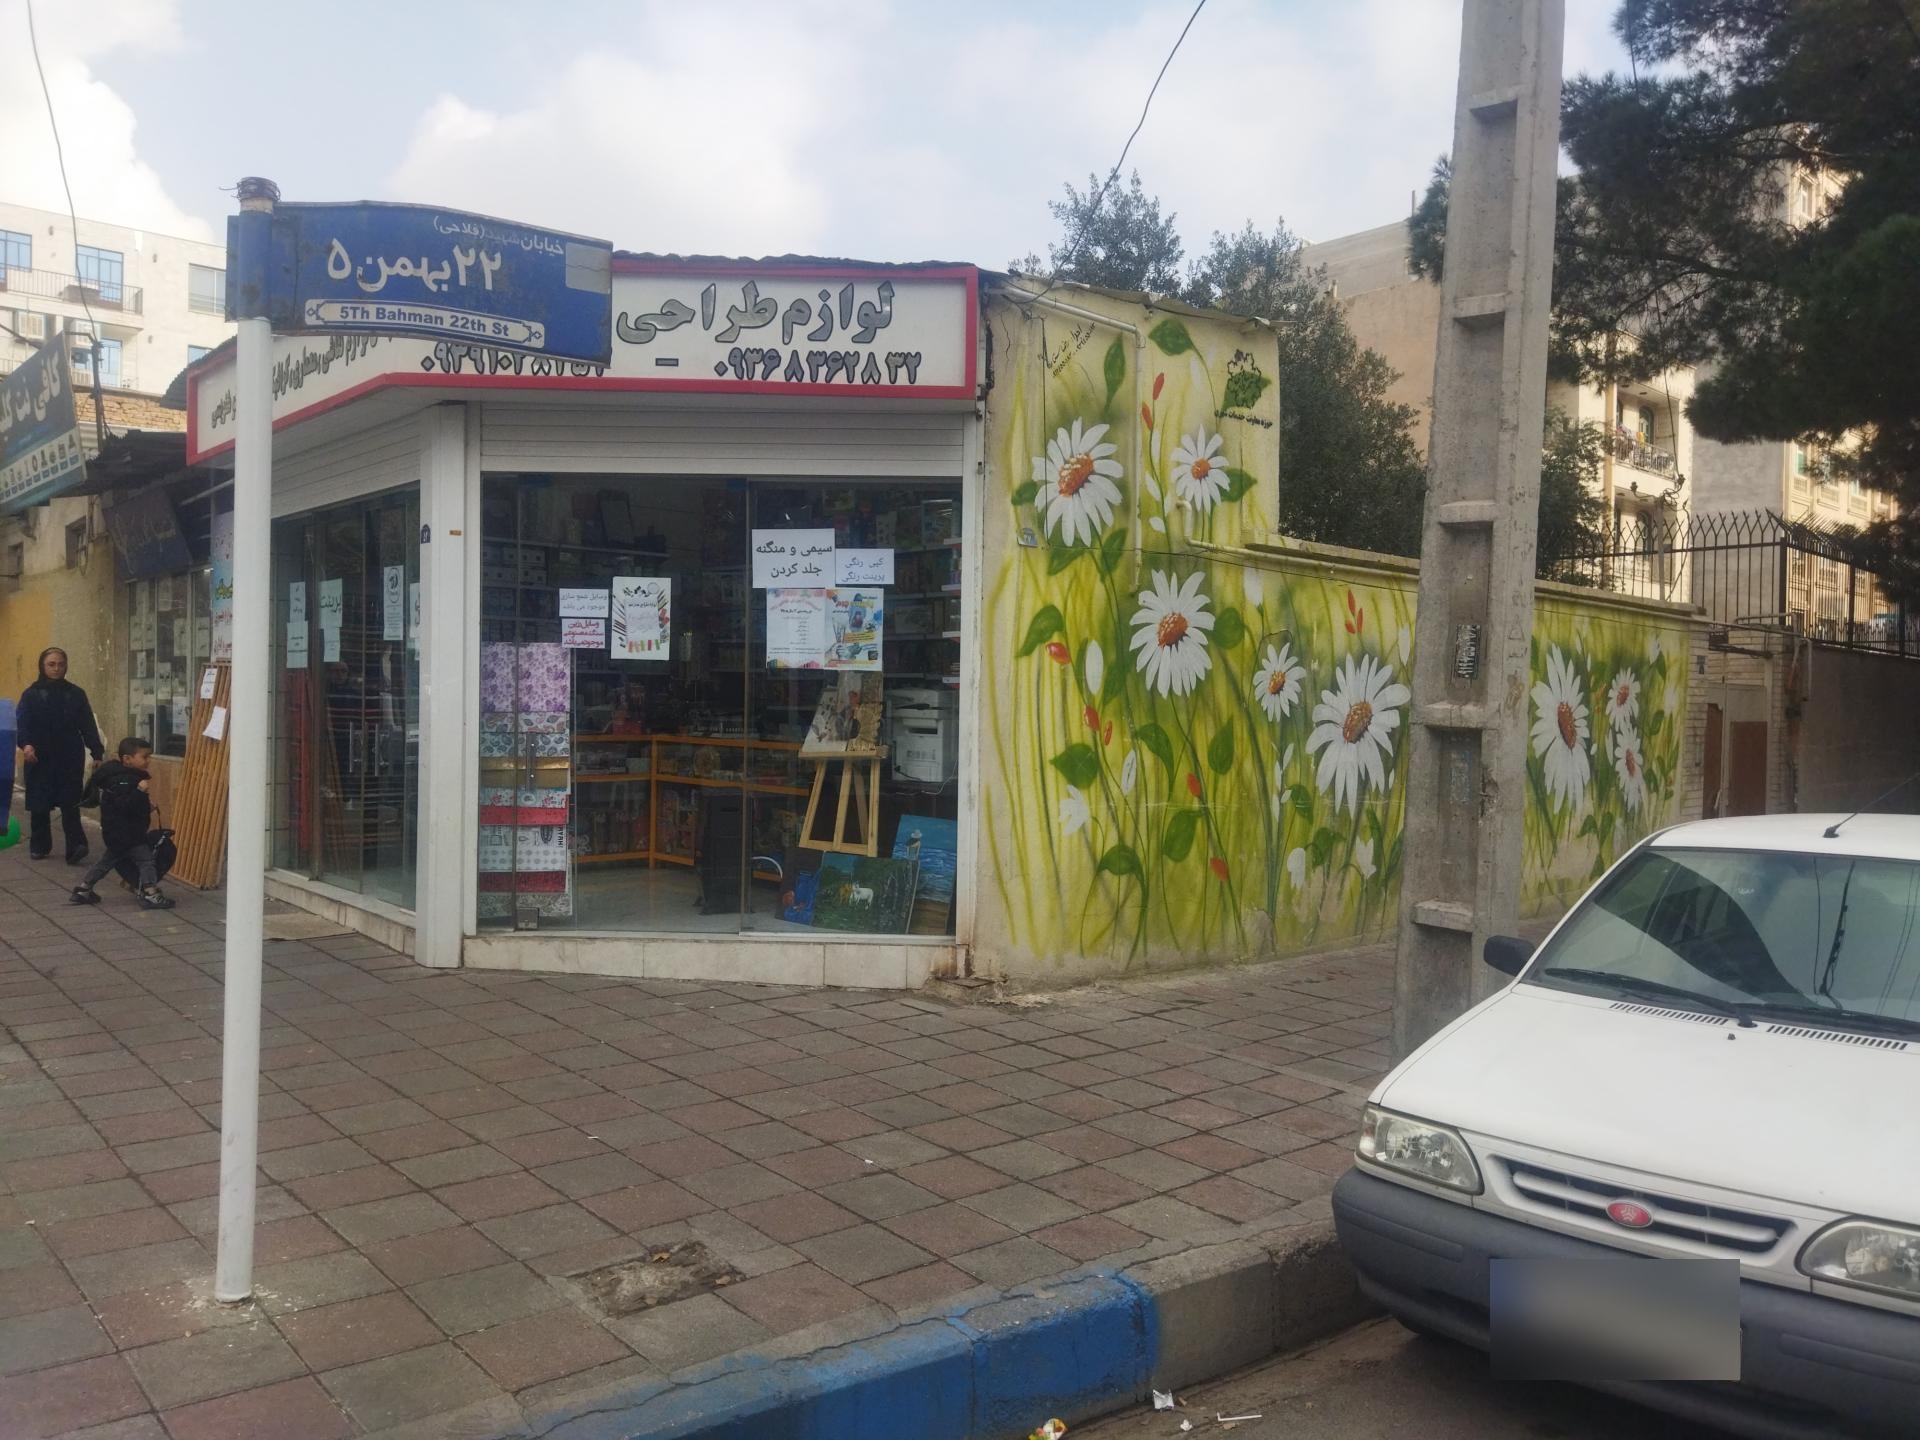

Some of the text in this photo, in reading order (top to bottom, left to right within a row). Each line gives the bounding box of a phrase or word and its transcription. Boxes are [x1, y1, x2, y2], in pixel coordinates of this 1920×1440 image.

[433, 215, 486, 239] (فلاحی)
[520, 235, 565, 256] خیابان
[326, 238, 502, 294] ۲۲ بهمن ۵
[339, 305, 510, 338] 5Th Bahman 22th St
[616, 280, 895, 345] لوازم طراحی
[34, 350, 61, 422] کافی
[756, 541, 833, 557] سیمی و منگنه
[770, 562, 822, 578] جلد کردن
[845, 557, 884, 569] کپی رنگی
[841, 571, 885, 582] پرینت رنگی
